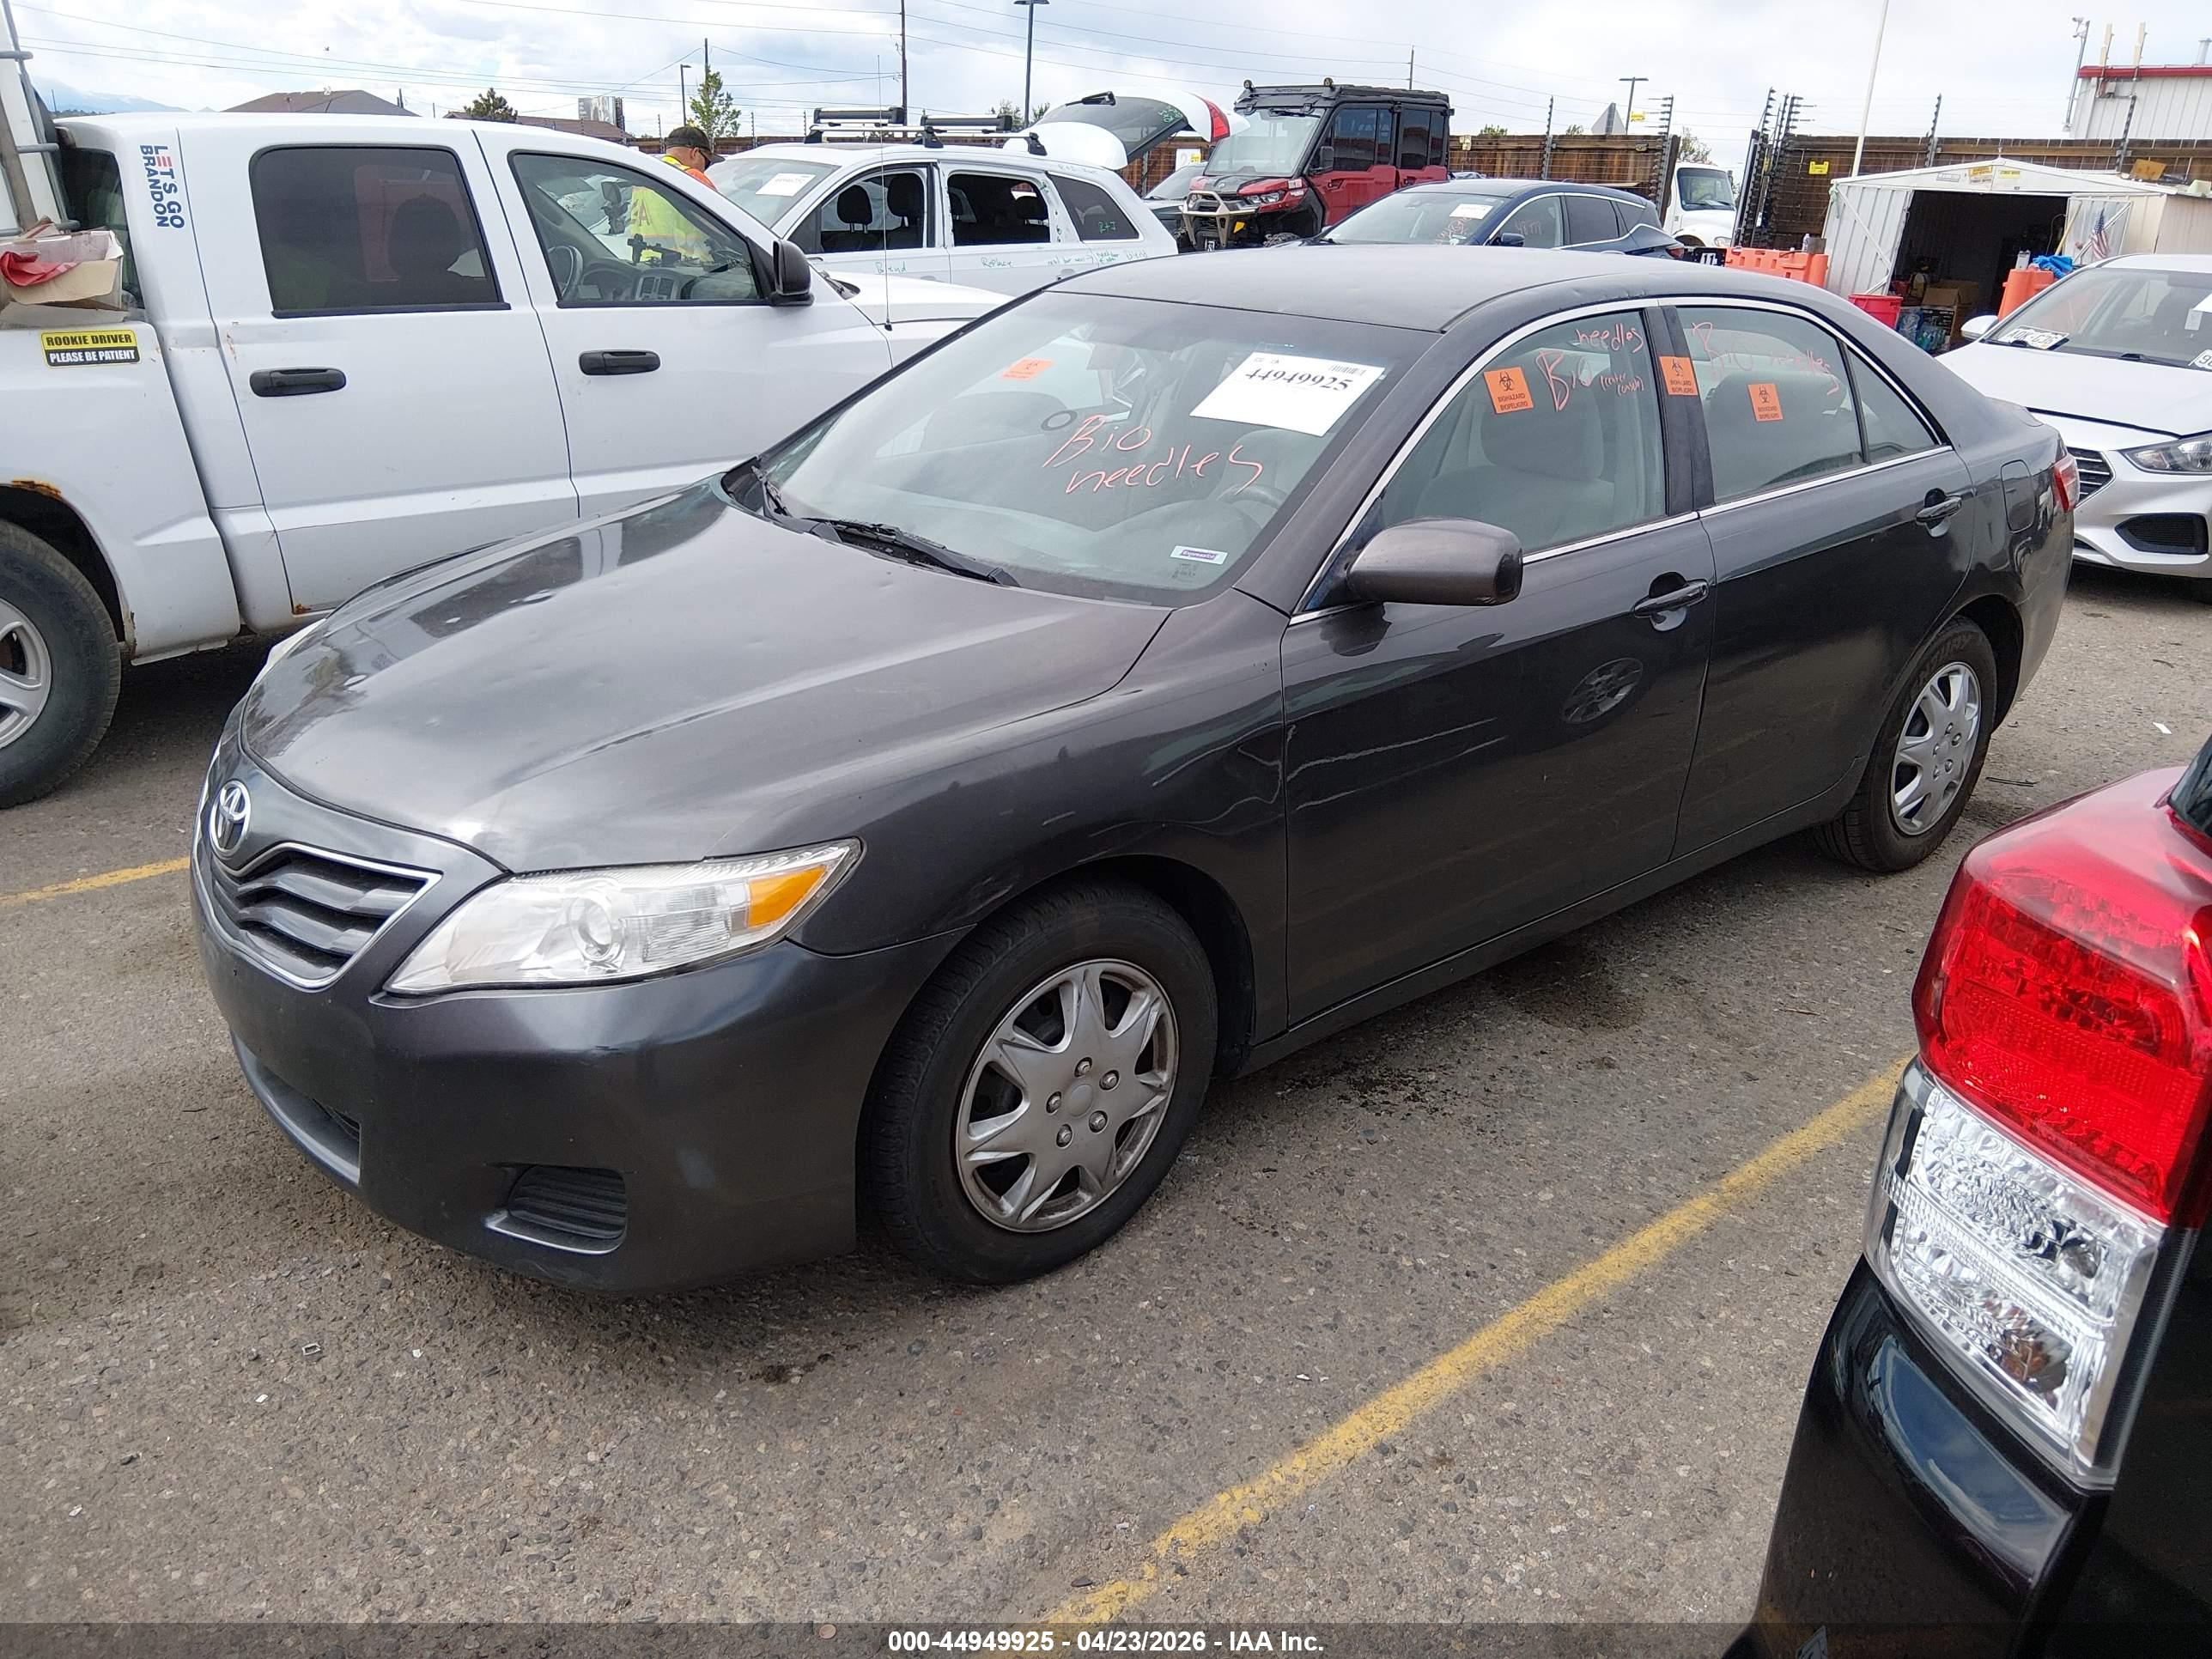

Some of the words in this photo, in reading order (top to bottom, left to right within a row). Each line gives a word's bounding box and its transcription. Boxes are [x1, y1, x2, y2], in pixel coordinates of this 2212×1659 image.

[140, 144, 170, 228] BRANDON
[167, 200, 185, 228] GO
[46, 335, 89, 346] ROOKIE
[91, 333, 132, 344] DRIVER
[49, 351, 84, 363] PLEASE
[85, 350, 98, 362] BE
[99, 349, 136, 361] PATIENT
[1245, 368, 1354, 391] 44949925
